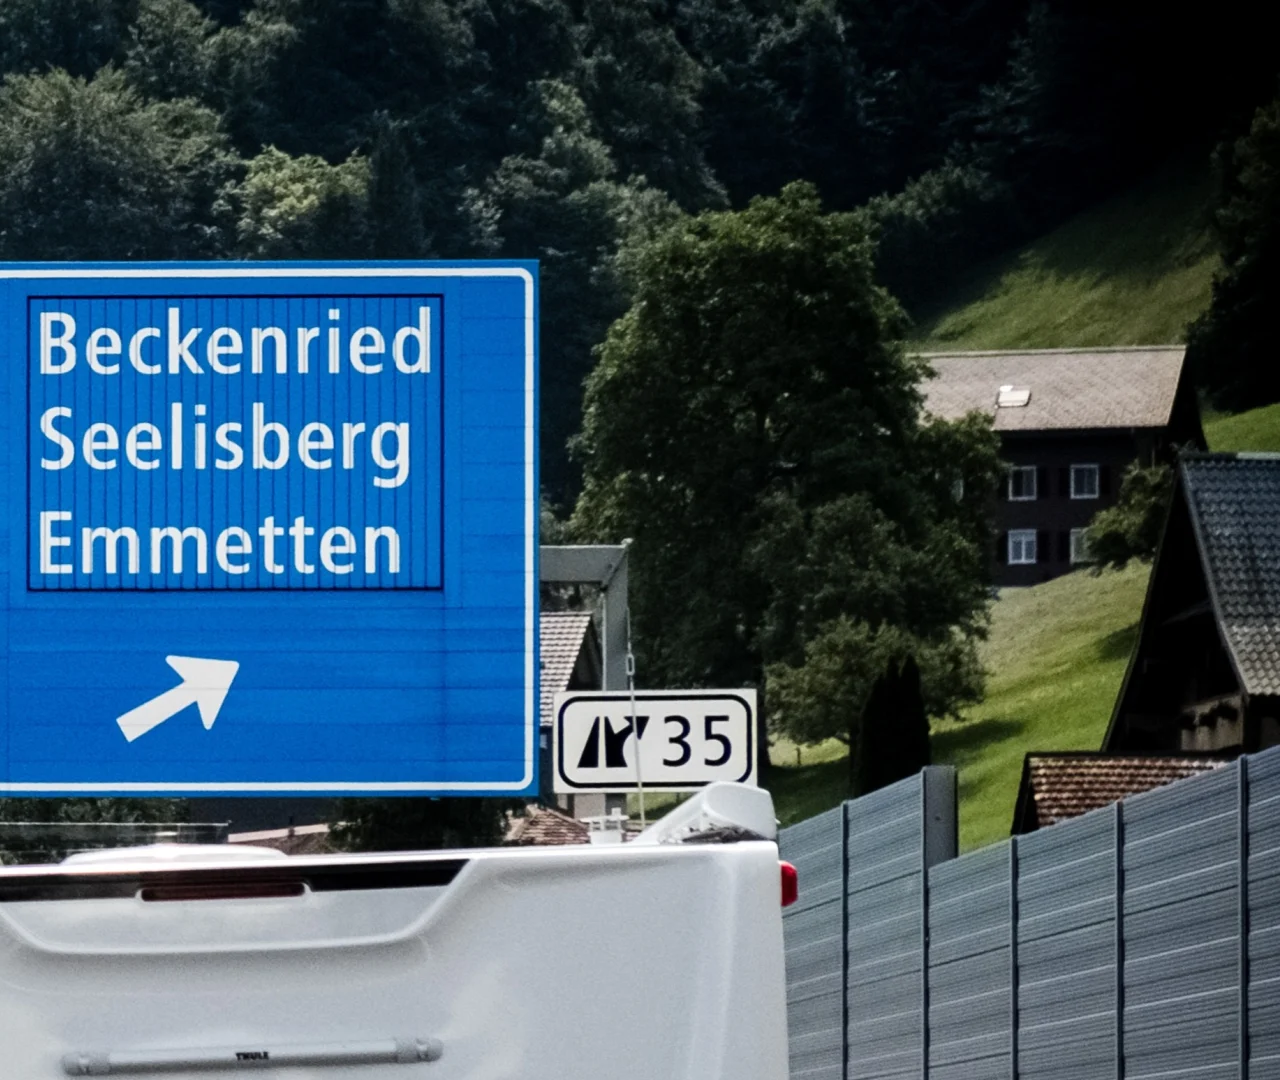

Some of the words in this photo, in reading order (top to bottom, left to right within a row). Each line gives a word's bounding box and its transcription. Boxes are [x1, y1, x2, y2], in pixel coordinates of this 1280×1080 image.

[40, 307, 431, 375] Beckenried
[40, 402, 410, 488] Seelisberg
[40, 511, 401, 575] Emmetten
[662, 715, 732, 767] 35
